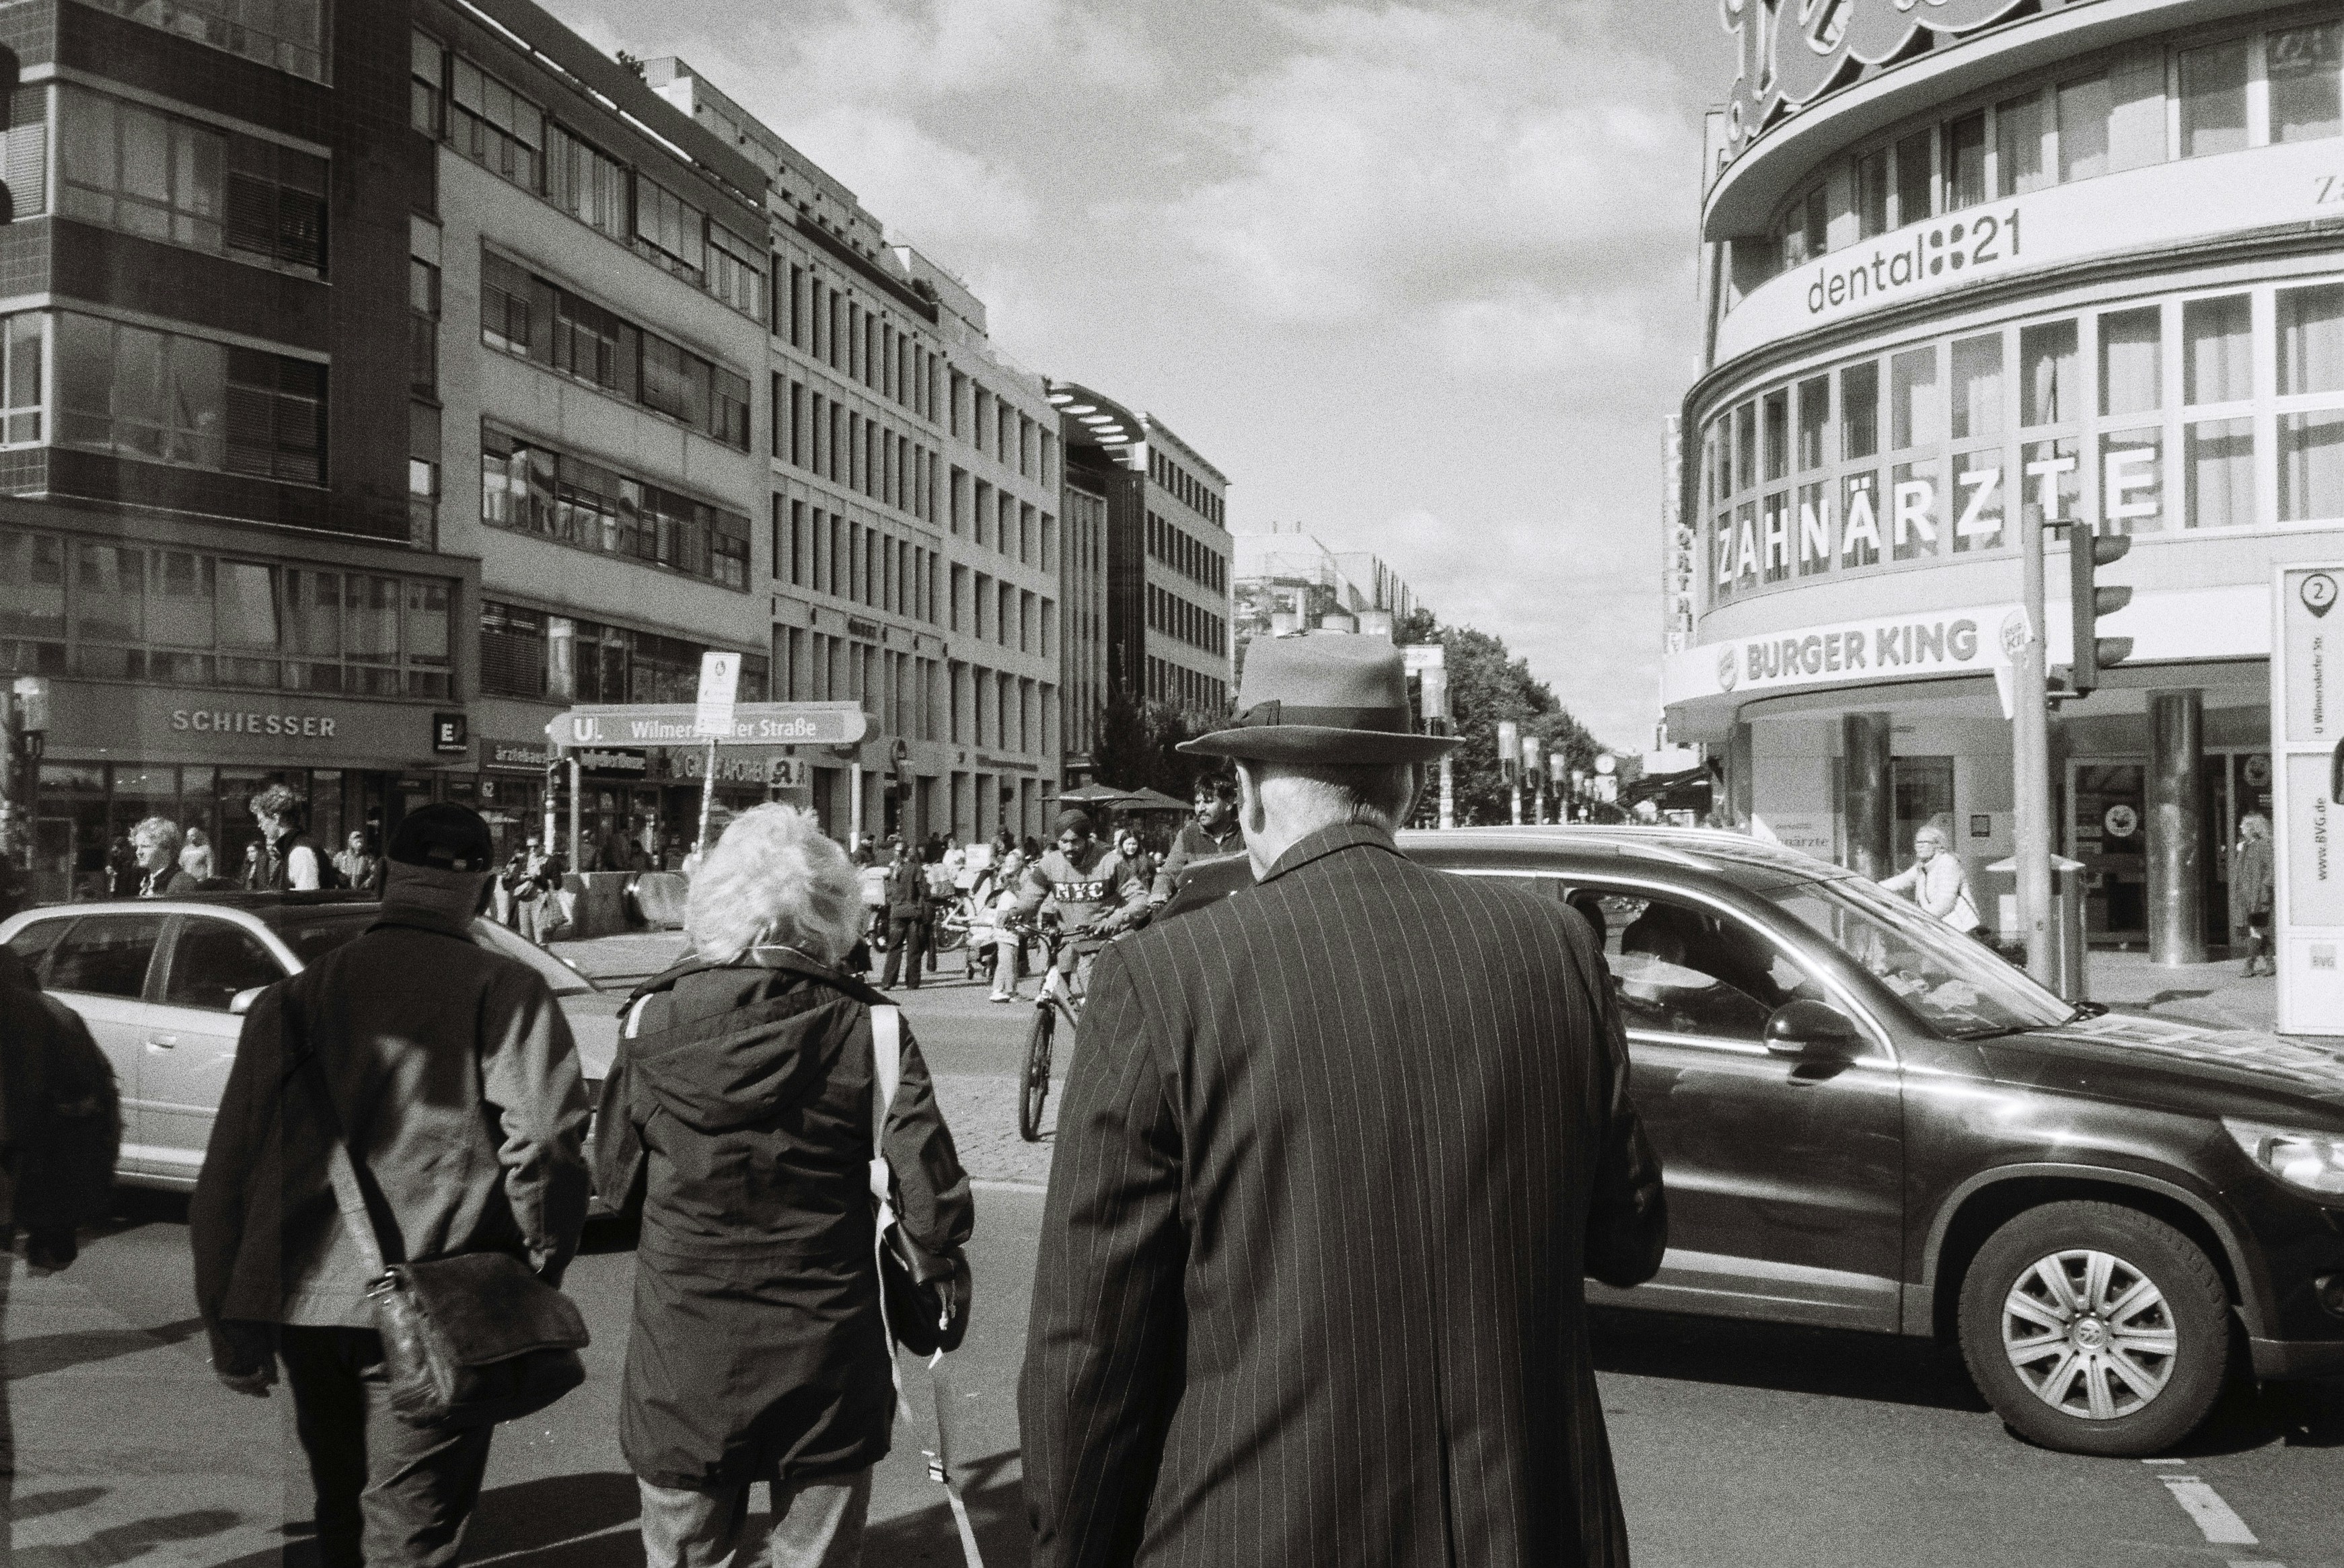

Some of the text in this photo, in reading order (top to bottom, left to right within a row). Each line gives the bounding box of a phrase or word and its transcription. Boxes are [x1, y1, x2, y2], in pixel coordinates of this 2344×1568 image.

[1808, 207, 2019, 314] dental 21
[1719, 447, 2157, 585] ZAHNÄRZTE
[2313, 582, 2323, 600] 2
[1746, 630, 1867, 681] BURGER
[1875, 618, 1978, 667] KING
[172, 709, 336, 737] SCHIESSER
[441, 722, 453, 742] E
[760, 717, 817, 738] Straße
[2314, 726, 2323, 735] U
[2313, 796, 2327, 881] www.BVG.de
[1054, 882, 1104, 899] NYC
[2312, 956, 2335, 967] BVG
